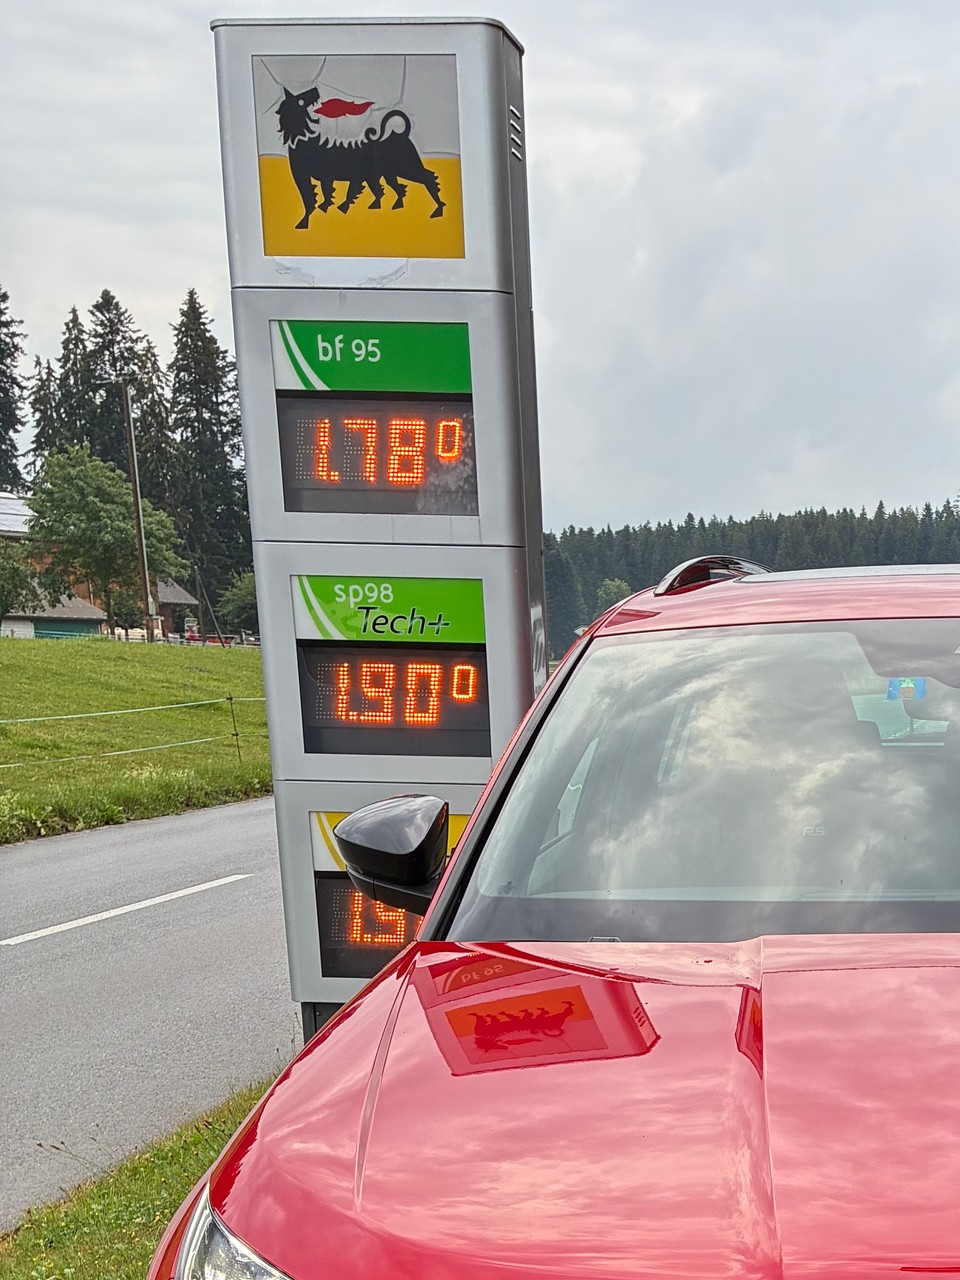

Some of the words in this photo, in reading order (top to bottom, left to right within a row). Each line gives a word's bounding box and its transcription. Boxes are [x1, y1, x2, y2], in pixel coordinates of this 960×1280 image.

[317, 334, 344, 362] bf
[351, 338, 381, 363] 95
[333, 583, 394, 609] sp98
[356, 605, 450, 636] Tech+
